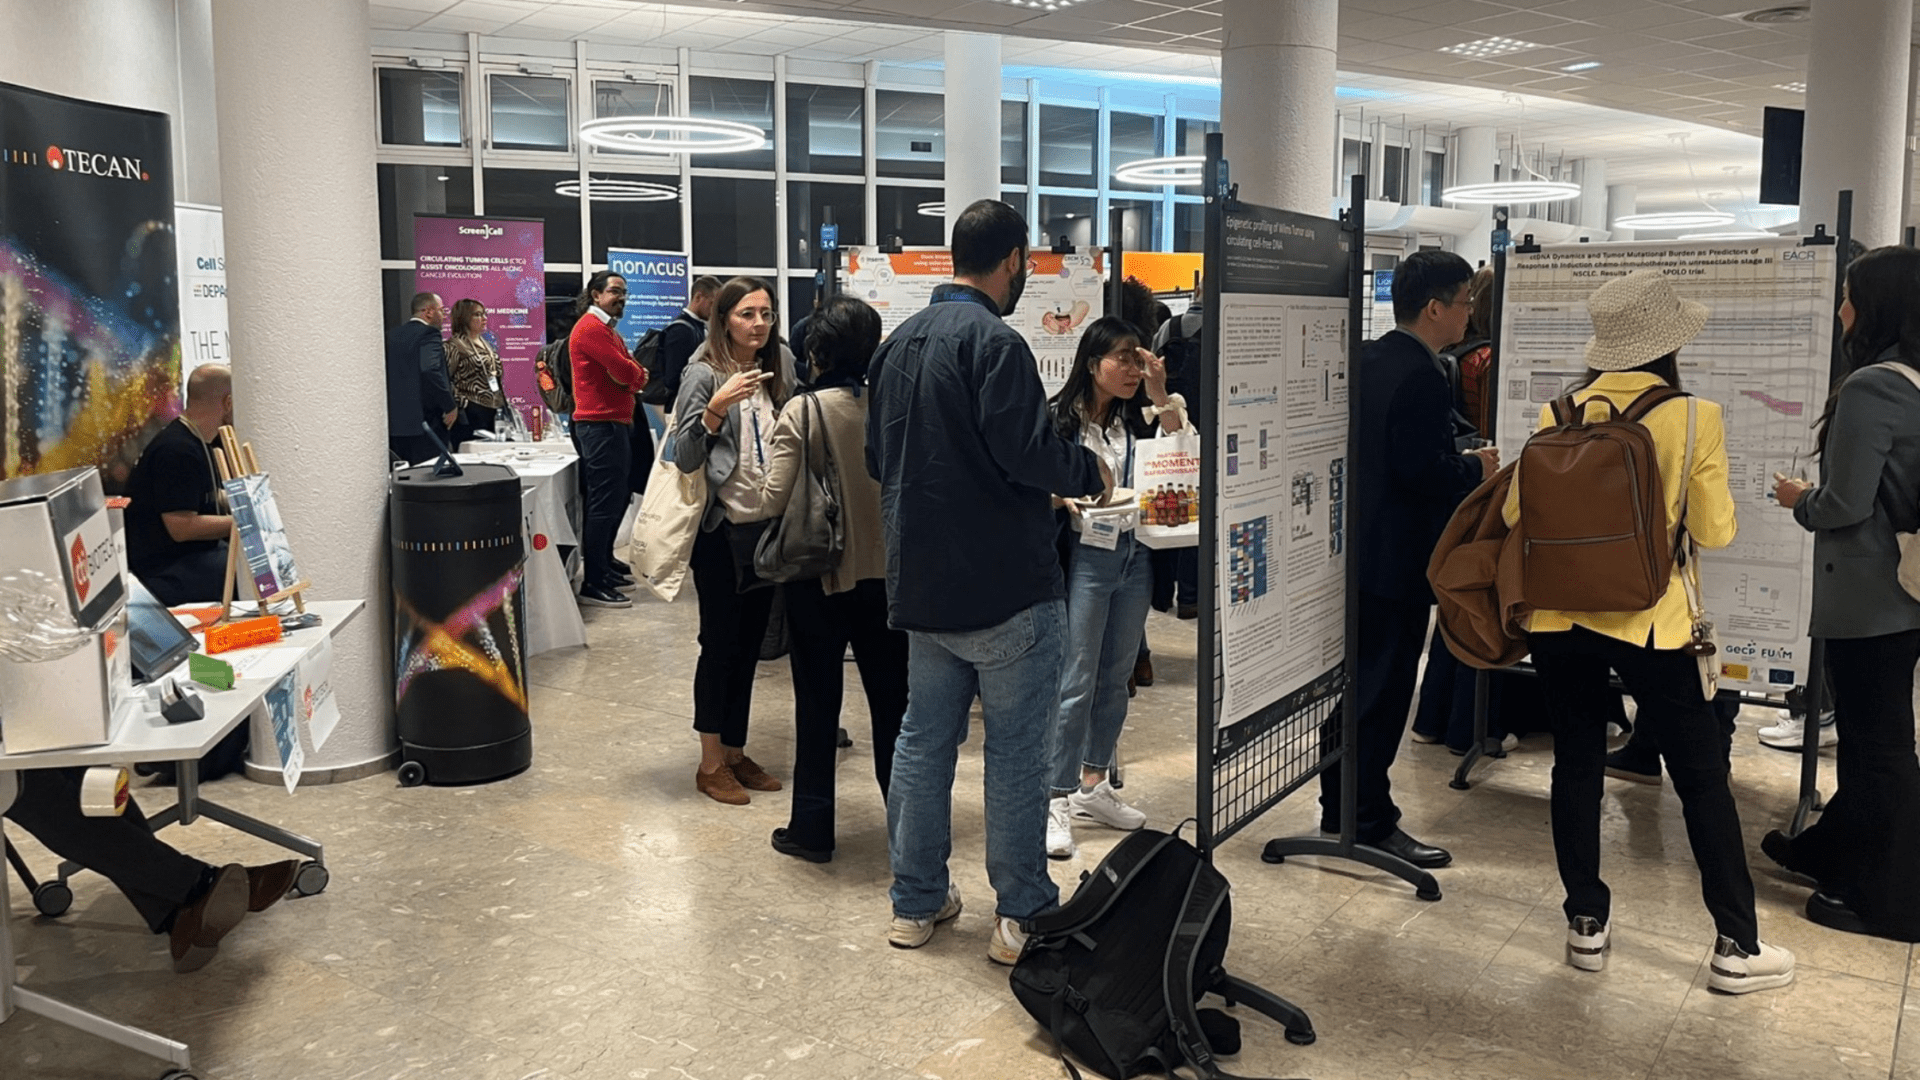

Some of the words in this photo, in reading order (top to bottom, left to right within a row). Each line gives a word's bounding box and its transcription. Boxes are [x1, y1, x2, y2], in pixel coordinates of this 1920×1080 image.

[1226, 216, 1252, 230] Epigenetic
[1253, 220, 1273, 234] profiling
[823, 240, 834, 248] 14
[1226, 235, 1252, 250] circulating
[1253, 237, 1272, 249] cell-free
[1272, 239, 1283, 250] DNA
[420, 255, 464, 263] CIRCULATING
[465, 256, 489, 264] TUMOR
[1553, 253, 1585, 262] Dynamics
[1627, 250, 1666, 258] Mutational
[1709, 248, 1748, 256] Predictors
[1783, 251, 1816, 261] EACR
[197, 256, 216, 271] Cell
[1517, 262, 1549, 270] Response
[1594, 259, 1677, 269] chemo-immunotherapy
[1740, 257, 1762, 265] stage
[190, 330, 221, 360] THE
[1152, 458, 1200, 468] MOMENT
